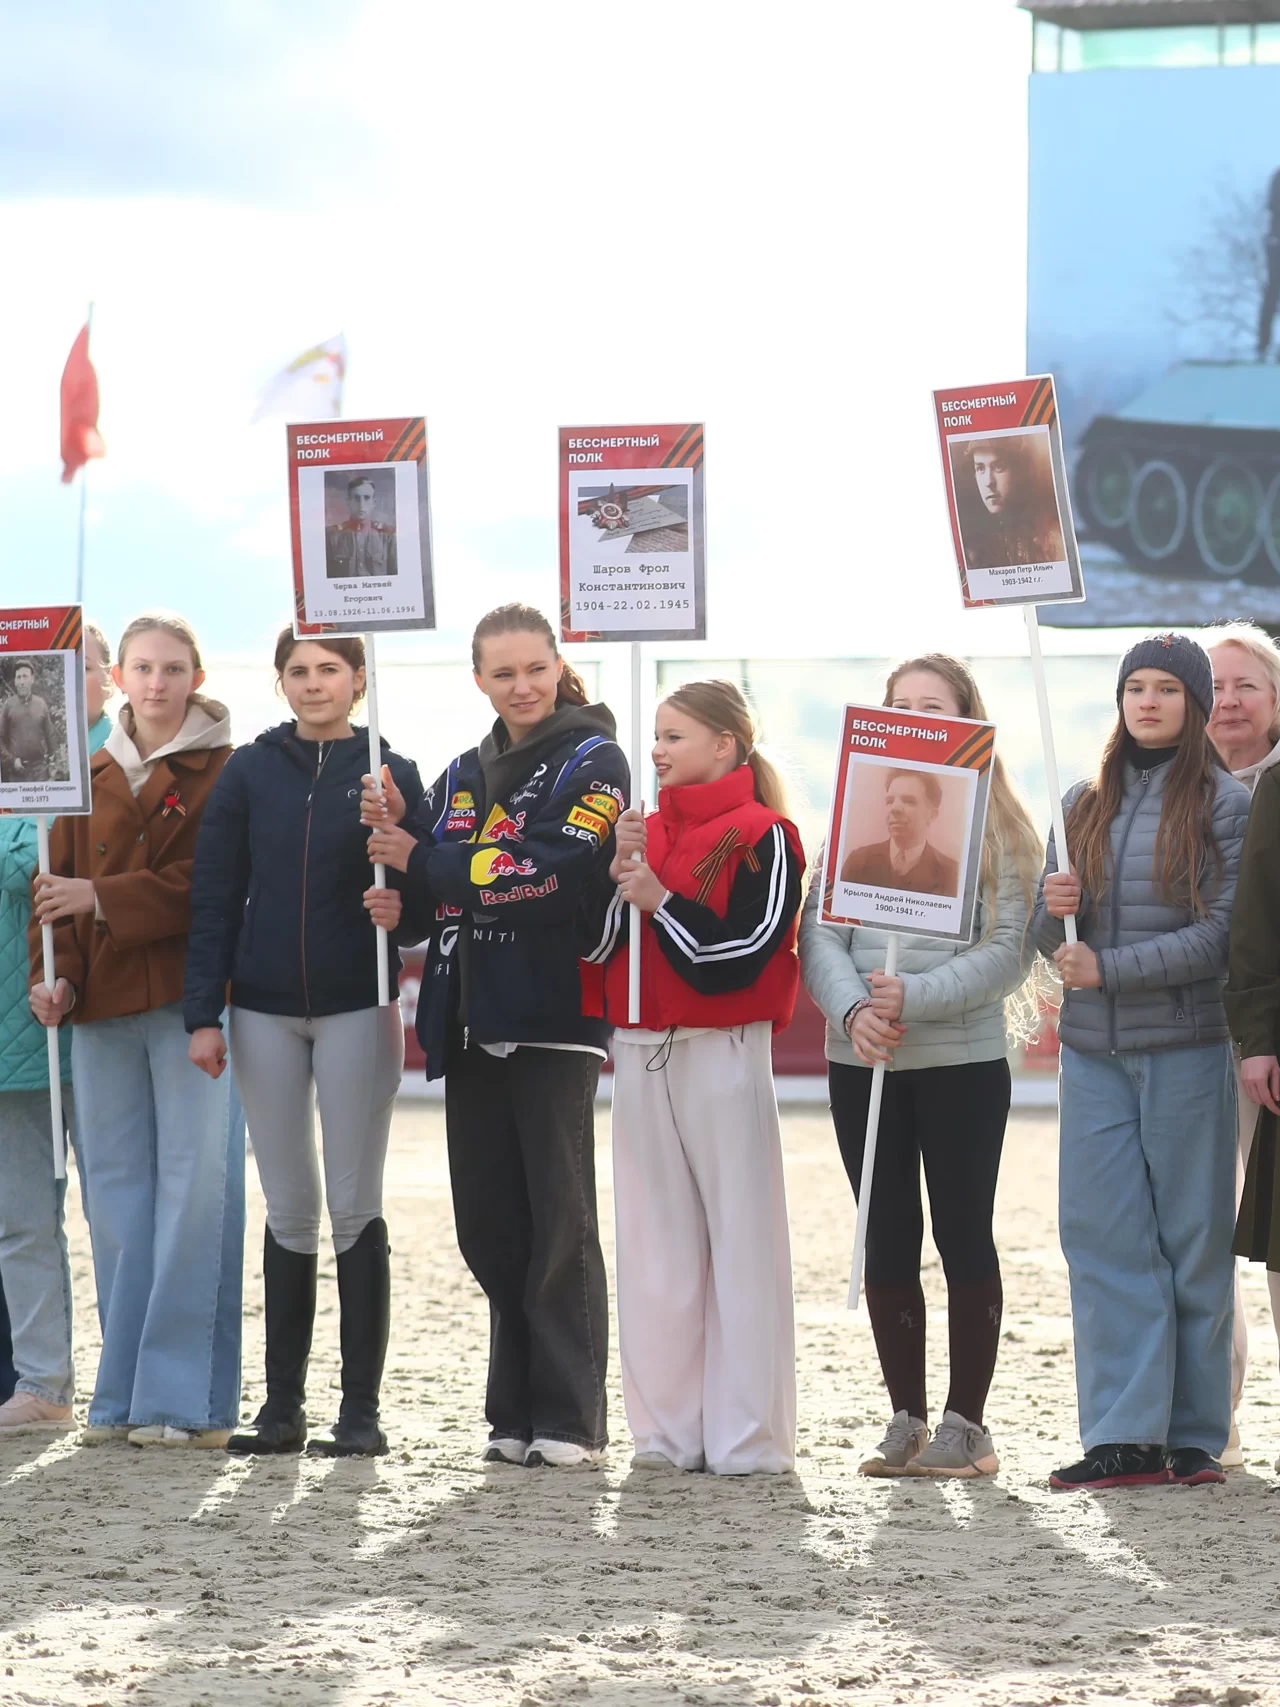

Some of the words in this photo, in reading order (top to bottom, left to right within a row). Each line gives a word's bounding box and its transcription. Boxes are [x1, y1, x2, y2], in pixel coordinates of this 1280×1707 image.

[941, 391, 1017, 412] БЕССМЕРТНЫЙ
[943, 415, 972, 427] ПОЛК
[296, 429, 384, 445] БЕССМЕРТНЫЙ
[568, 434, 660, 448] БЕССМЕРТНЫЙ
[297, 448, 330, 459] ПОЛК
[568, 453, 603, 463] ПОЛК
[593, 564, 631, 576] Шаров
[638, 563, 670, 575] Фрол
[988, 568, 1016, 576] Макаров
[1017, 566, 1032, 574] Петр
[578, 582, 686, 592] Константинович
[576, 600, 690, 611] 1904-22.02.1945
[852, 719, 948, 743] БЕССМЕРТНЫЙ
[850, 734, 887, 749] ПОЛК
[480, 887, 520, 905] Red
[521, 874, 558, 900] Bull
[843, 888, 873, 899] Крылов
[874, 892, 904, 903] Андрей
[904, 898, 952, 910] Николаевич
[875, 904, 913, 916] 1900-1941
